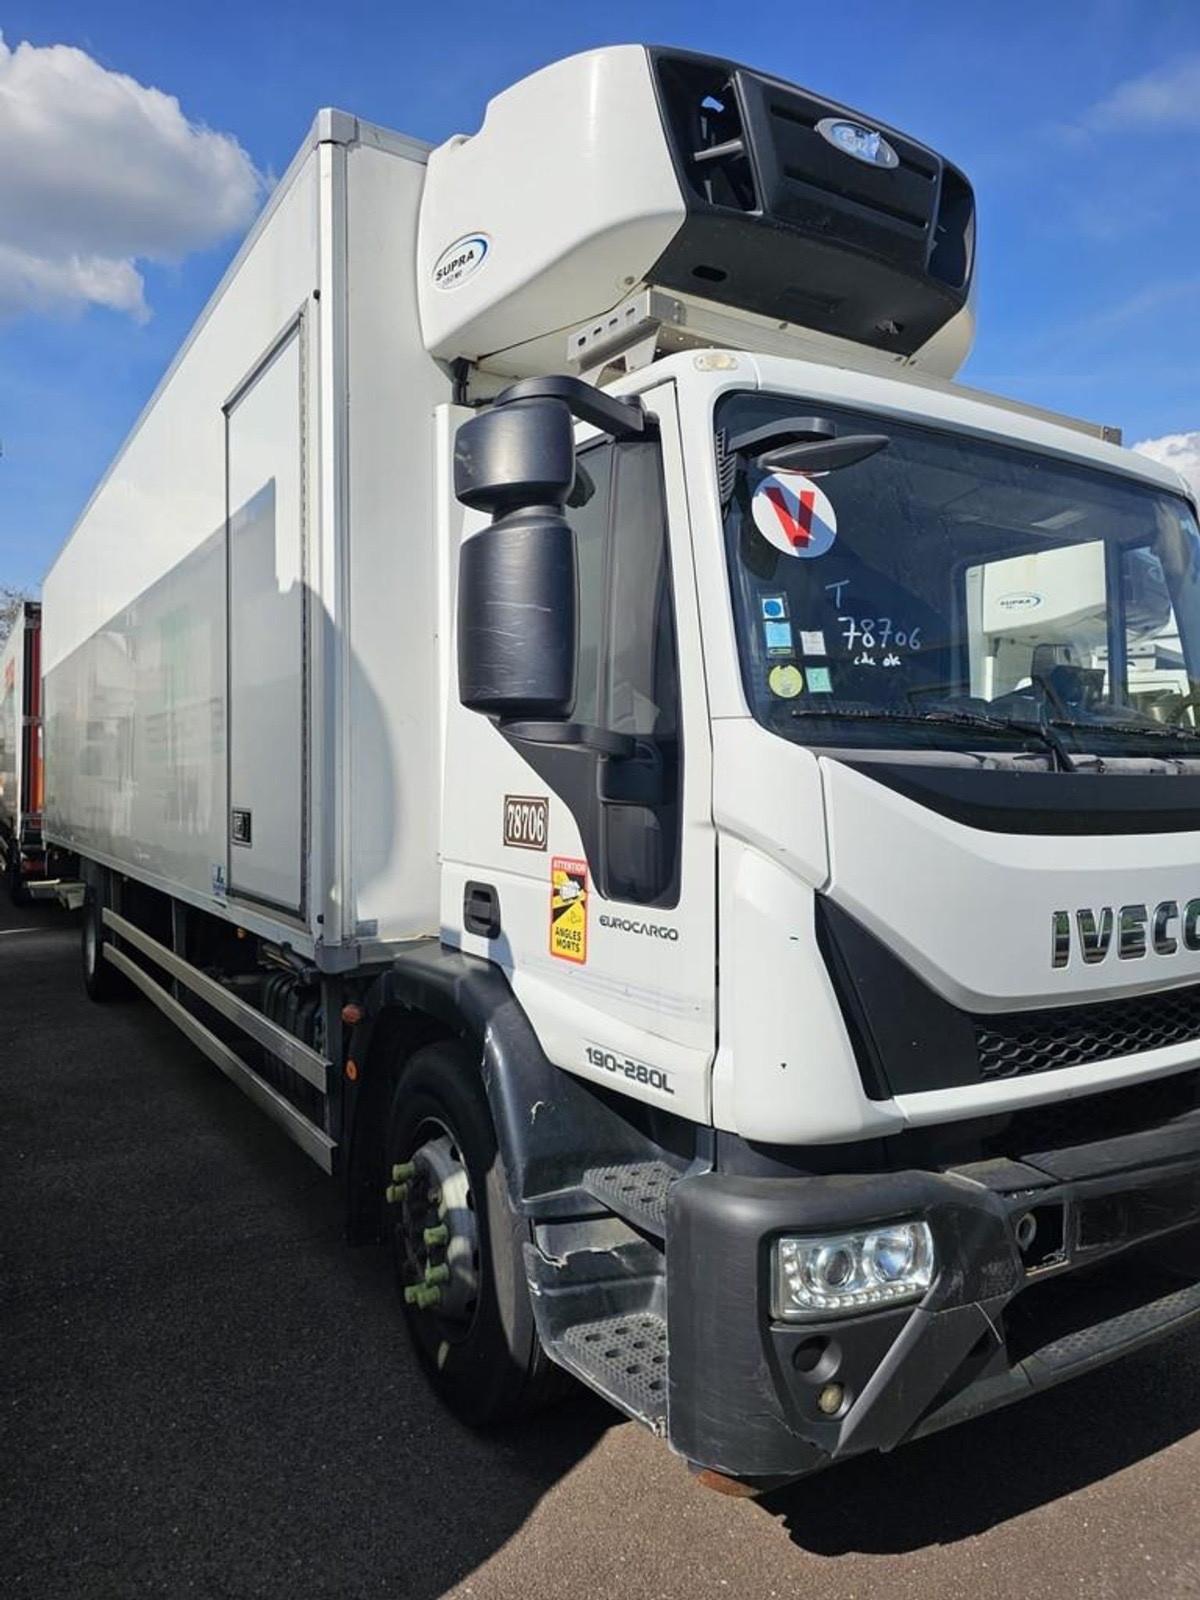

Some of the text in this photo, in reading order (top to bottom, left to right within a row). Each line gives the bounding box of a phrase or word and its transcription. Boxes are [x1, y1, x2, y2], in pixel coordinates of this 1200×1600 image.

[436, 250, 474, 281] SUPRA
[825, 579, 850, 608] T
[838, 616, 921, 651] 78706
[507, 805, 545, 842] 78706
[555, 926, 582, 942] ANGLES
[599, 915, 679, 942] EUROCARGO
[1051, 897, 1200, 969] IVECO
[556, 938, 581, 952] MORTS
[585, 1047, 675, 1094] 190-280L
